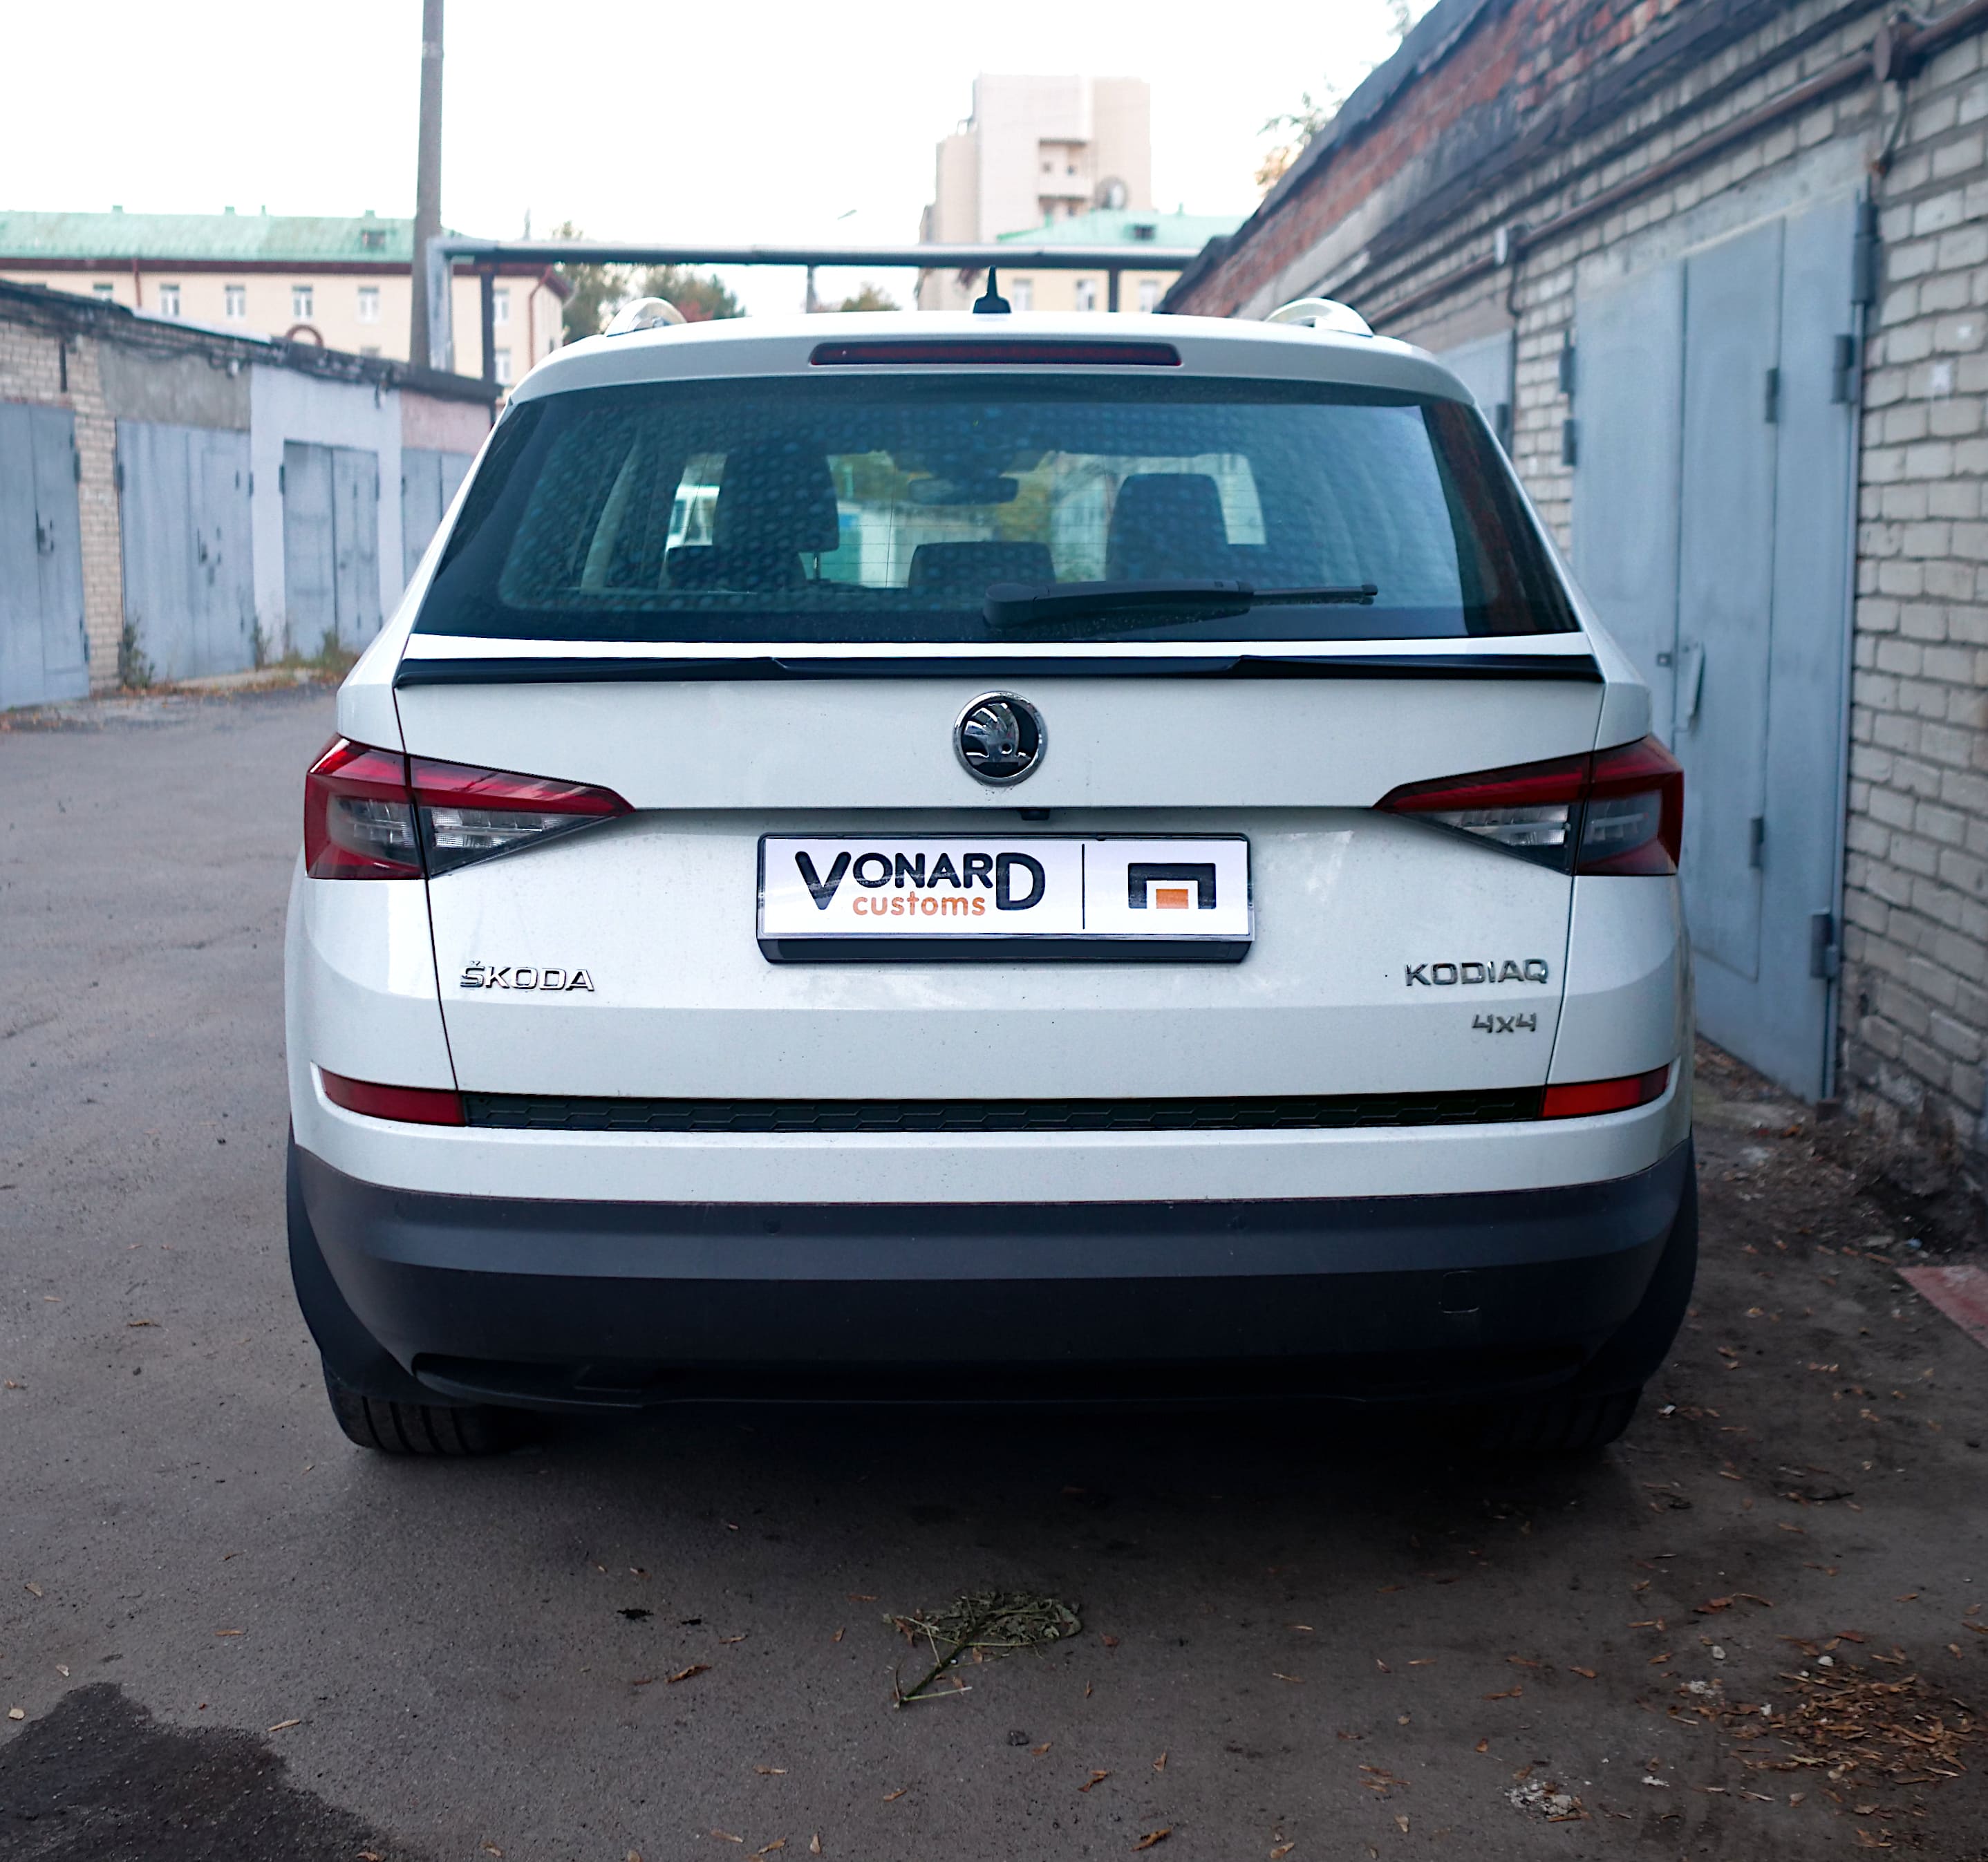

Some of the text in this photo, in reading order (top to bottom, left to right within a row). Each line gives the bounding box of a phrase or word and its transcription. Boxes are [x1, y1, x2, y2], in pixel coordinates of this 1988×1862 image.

[794, 851, 1046, 911] VONARD
[852, 891, 986, 916] customs
[1404, 958, 1549, 986] KODIAQ
[1472, 1012, 1537, 1033] 4x4
